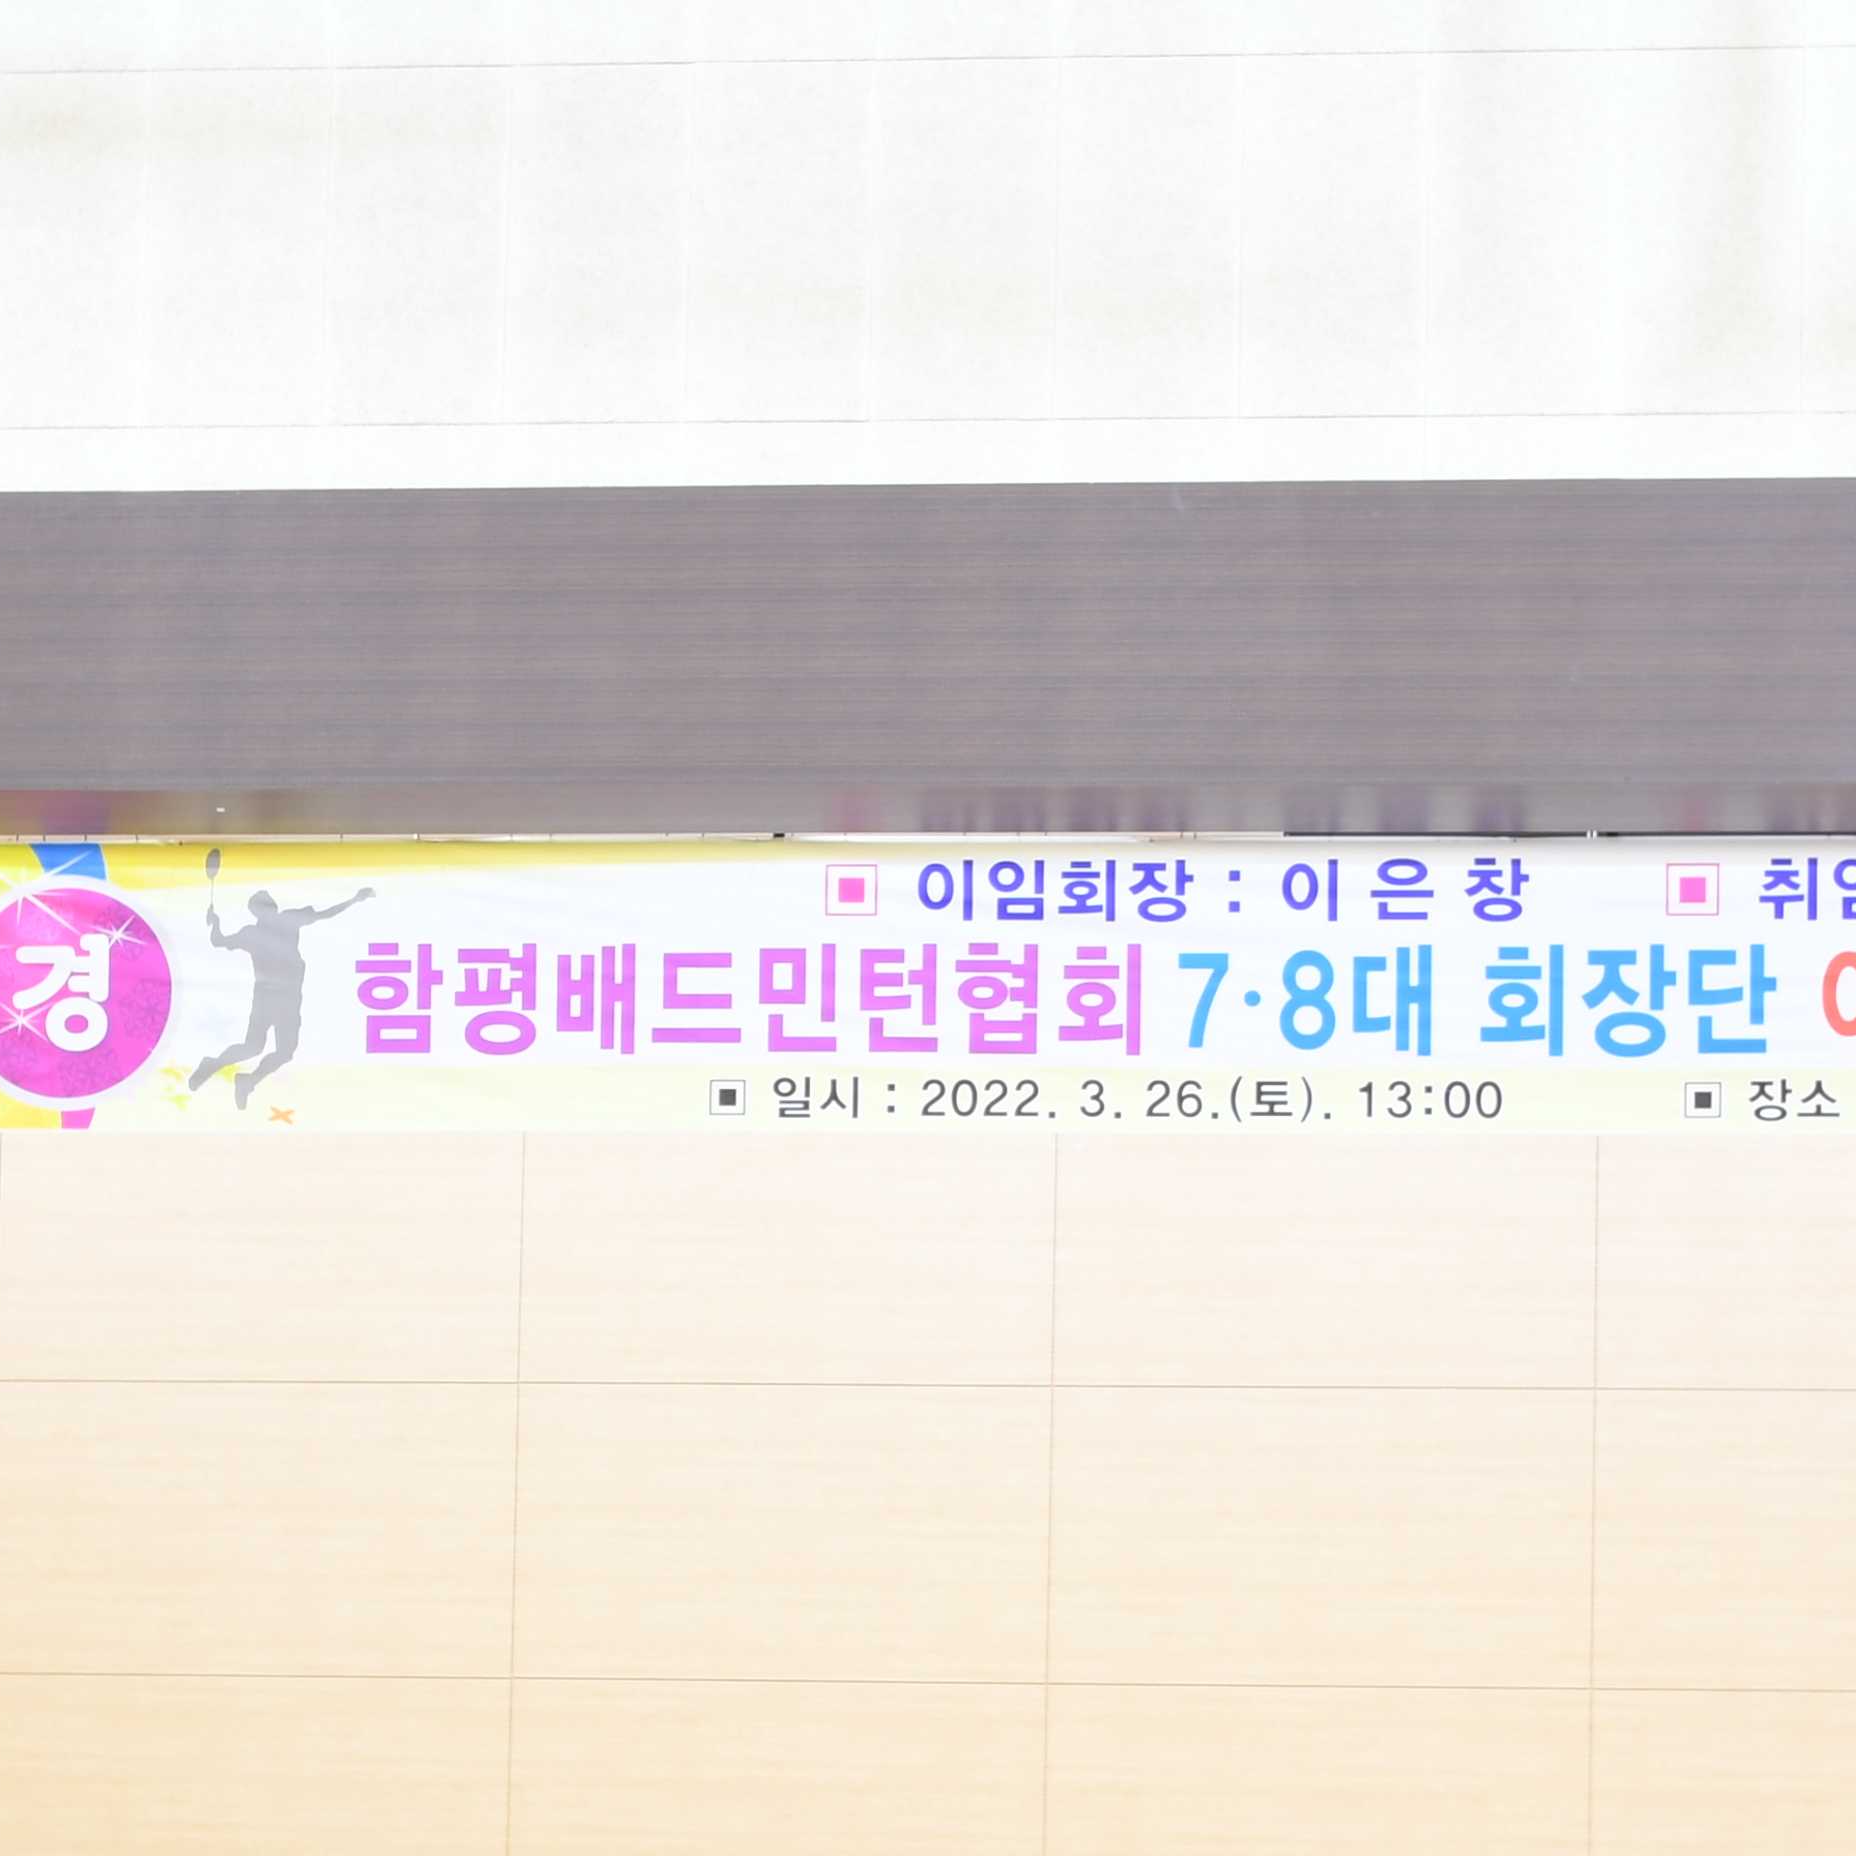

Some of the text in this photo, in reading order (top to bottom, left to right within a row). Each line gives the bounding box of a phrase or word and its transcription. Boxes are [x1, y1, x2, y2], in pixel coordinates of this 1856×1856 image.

[919, 859, 1193, 923] 이임회장
[13, 932, 112, 1052] 경
[356, 942, 1141, 1056] 함평배드민턴협회
[1178, 943, 1432, 1057] 7·8대
[1480, 943, 1777, 1058] 회장단
[774, 1076, 858, 1119] 일시
[1360, 1080, 1501, 1119] 13:00
[1750, 1078, 1839, 1122] 장소
